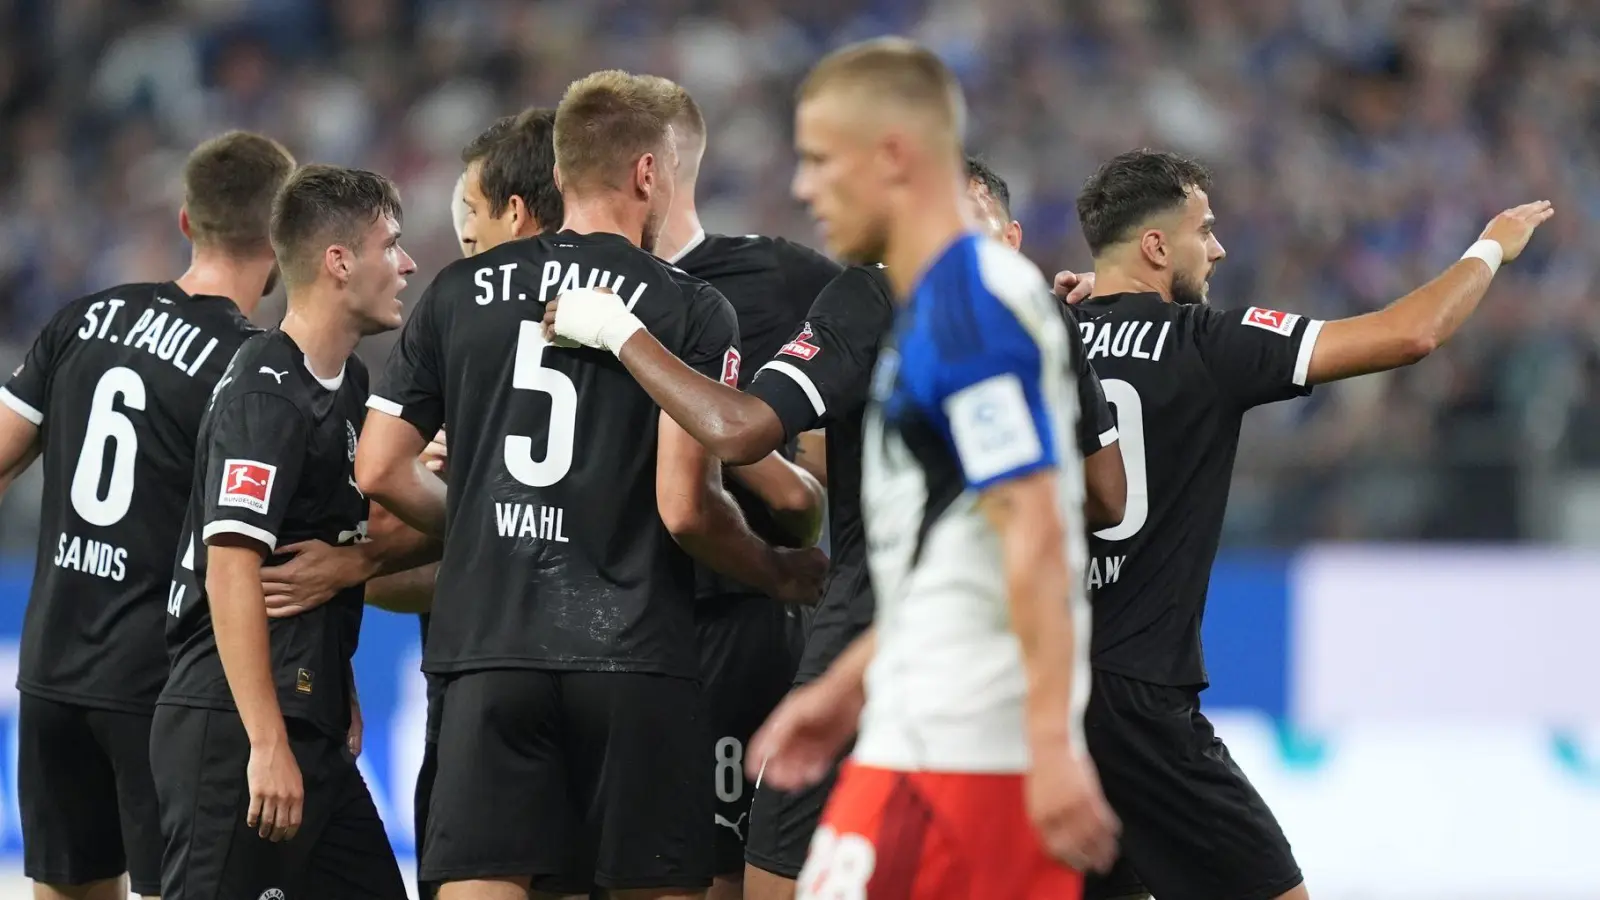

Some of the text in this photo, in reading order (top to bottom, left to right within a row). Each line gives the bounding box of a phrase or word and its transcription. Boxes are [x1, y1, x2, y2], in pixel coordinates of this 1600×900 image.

[473, 262, 526, 306] ST.
[78, 299, 219, 377] ST. PAULI
[1078, 320, 1171, 362] PAULI
[504, 320, 578, 488] 5
[70, 366, 147, 527] 6
[495, 502, 569, 543] WAHL
[54, 532, 128, 582] SANDS
[714, 736, 743, 803] 8
